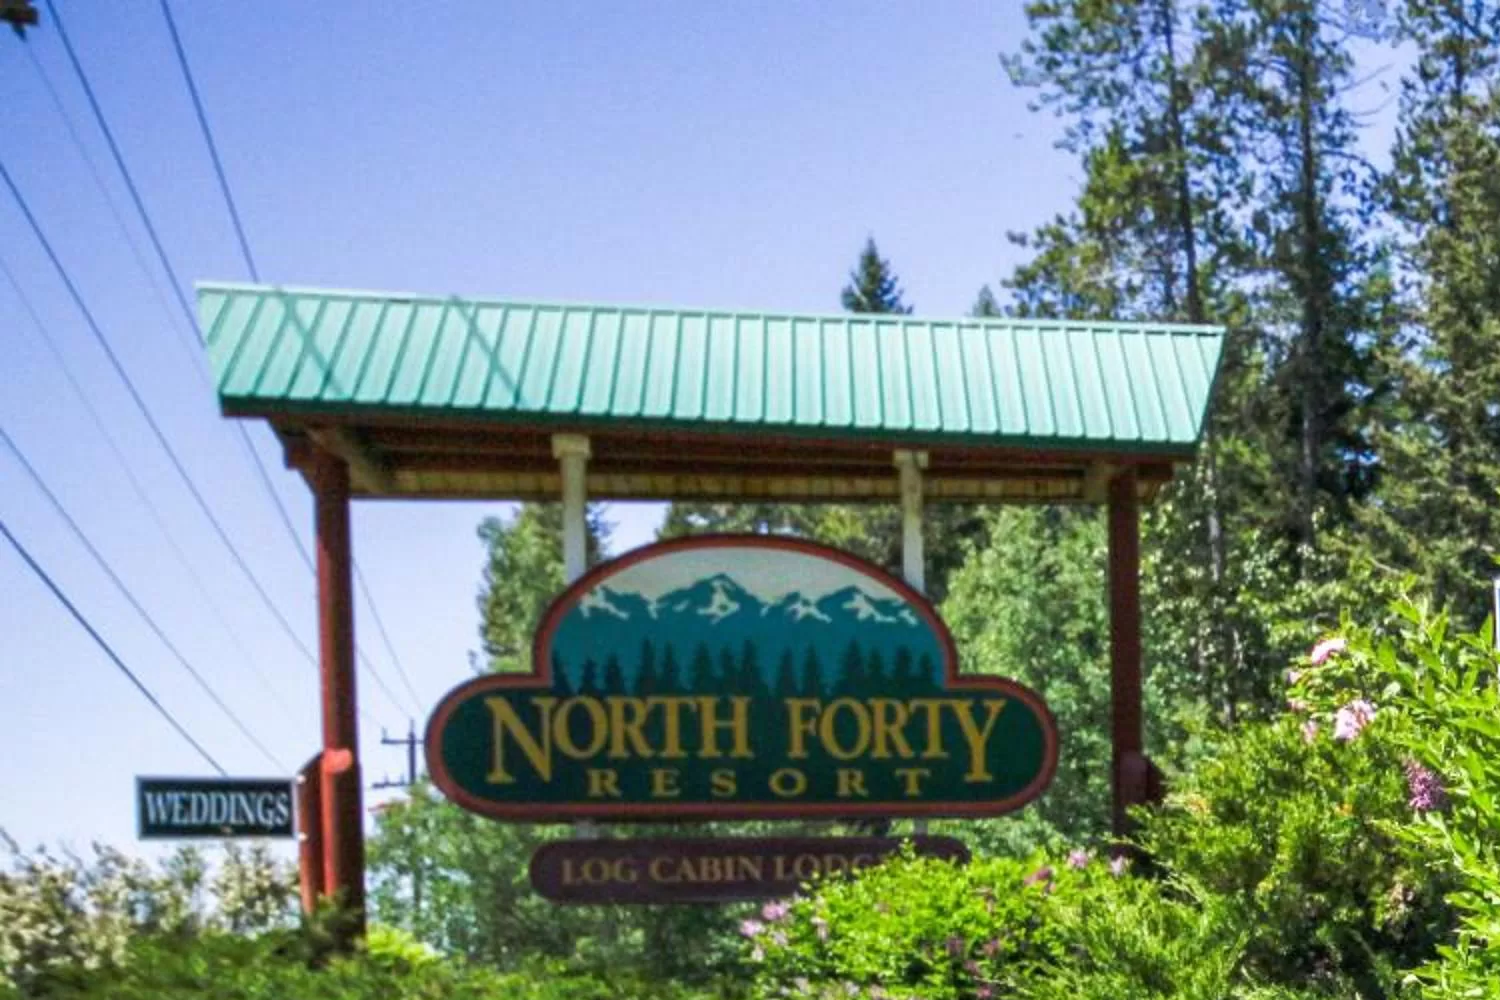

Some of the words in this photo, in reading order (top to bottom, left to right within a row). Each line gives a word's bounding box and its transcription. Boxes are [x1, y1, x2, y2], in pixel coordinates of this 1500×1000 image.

[483, 695, 755, 784] NORTH
[785, 696, 1007, 783] FORTY
[587, 768, 931, 797] RESORT
[144, 791, 290, 826] WEDDINGS
[561, 857, 639, 885] LOG
[650, 855, 763, 883] CABIN
